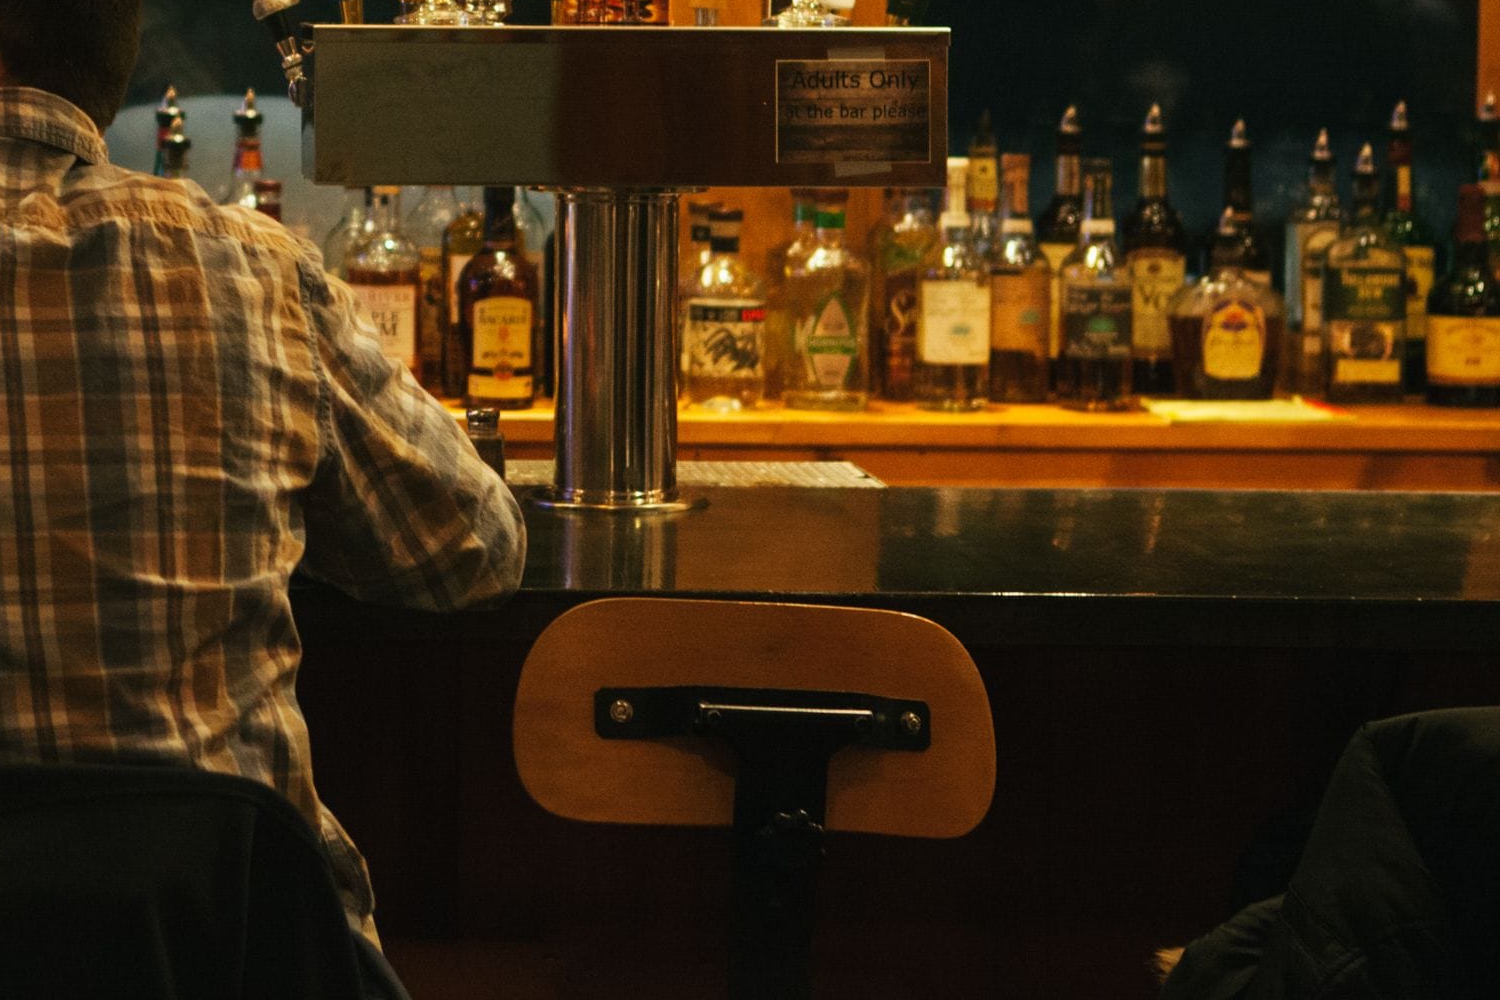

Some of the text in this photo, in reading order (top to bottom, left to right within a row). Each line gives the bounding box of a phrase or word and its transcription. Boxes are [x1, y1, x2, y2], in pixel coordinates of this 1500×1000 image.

[792, 69, 919, 91] Adults Only
[786, 104, 926, 121] at the bar please
